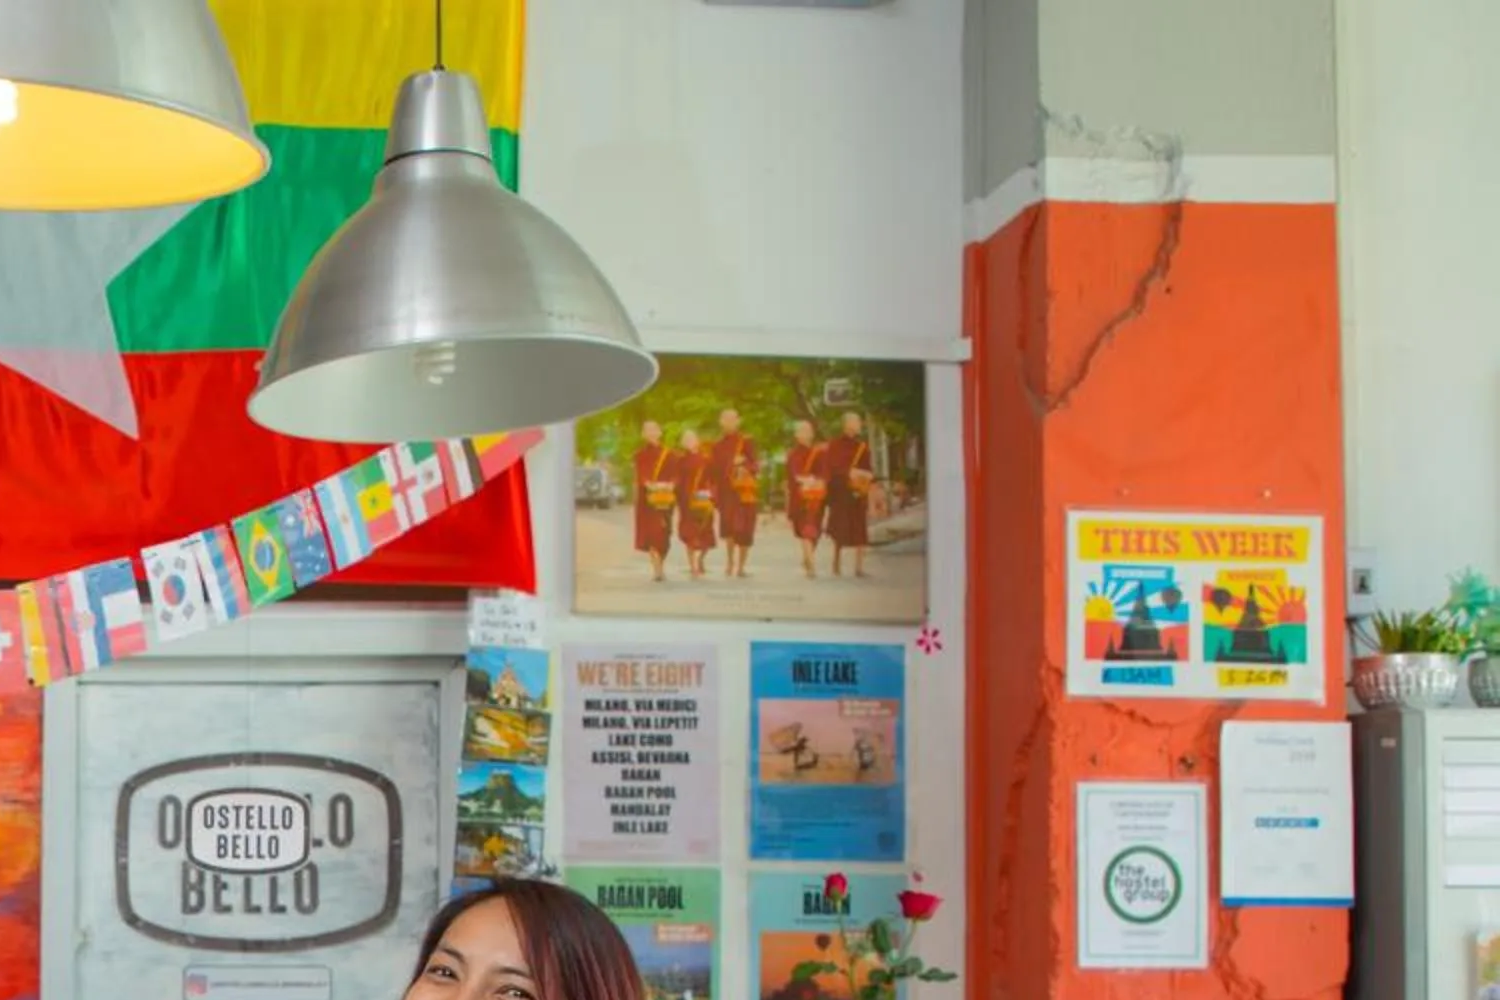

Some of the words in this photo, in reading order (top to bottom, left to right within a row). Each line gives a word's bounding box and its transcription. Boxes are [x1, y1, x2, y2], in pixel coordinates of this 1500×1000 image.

[1094, 527, 1181, 554] THIS
[1192, 529, 1297, 557] WEEK
[577, 661, 642, 687] WE'RE
[646, 662, 706, 688] EIGHT
[825, 661, 859, 685] LAKE
[635, 699, 653, 712] VIA
[632, 717, 651, 729] VIA
[654, 717, 698, 729] LEPETIT
[608, 734, 636, 747] LAKE
[647, 786, 677, 799] POOL
[203, 806, 293, 830] OSTELLO
[216, 835, 279, 859] BELLO
[1118, 864, 1145, 876] the
[1114, 874, 1166, 889] hostel
[597, 885, 646, 909] BAGAN
[649, 886, 684, 909] POOL
[1123, 889, 1171, 905] group
